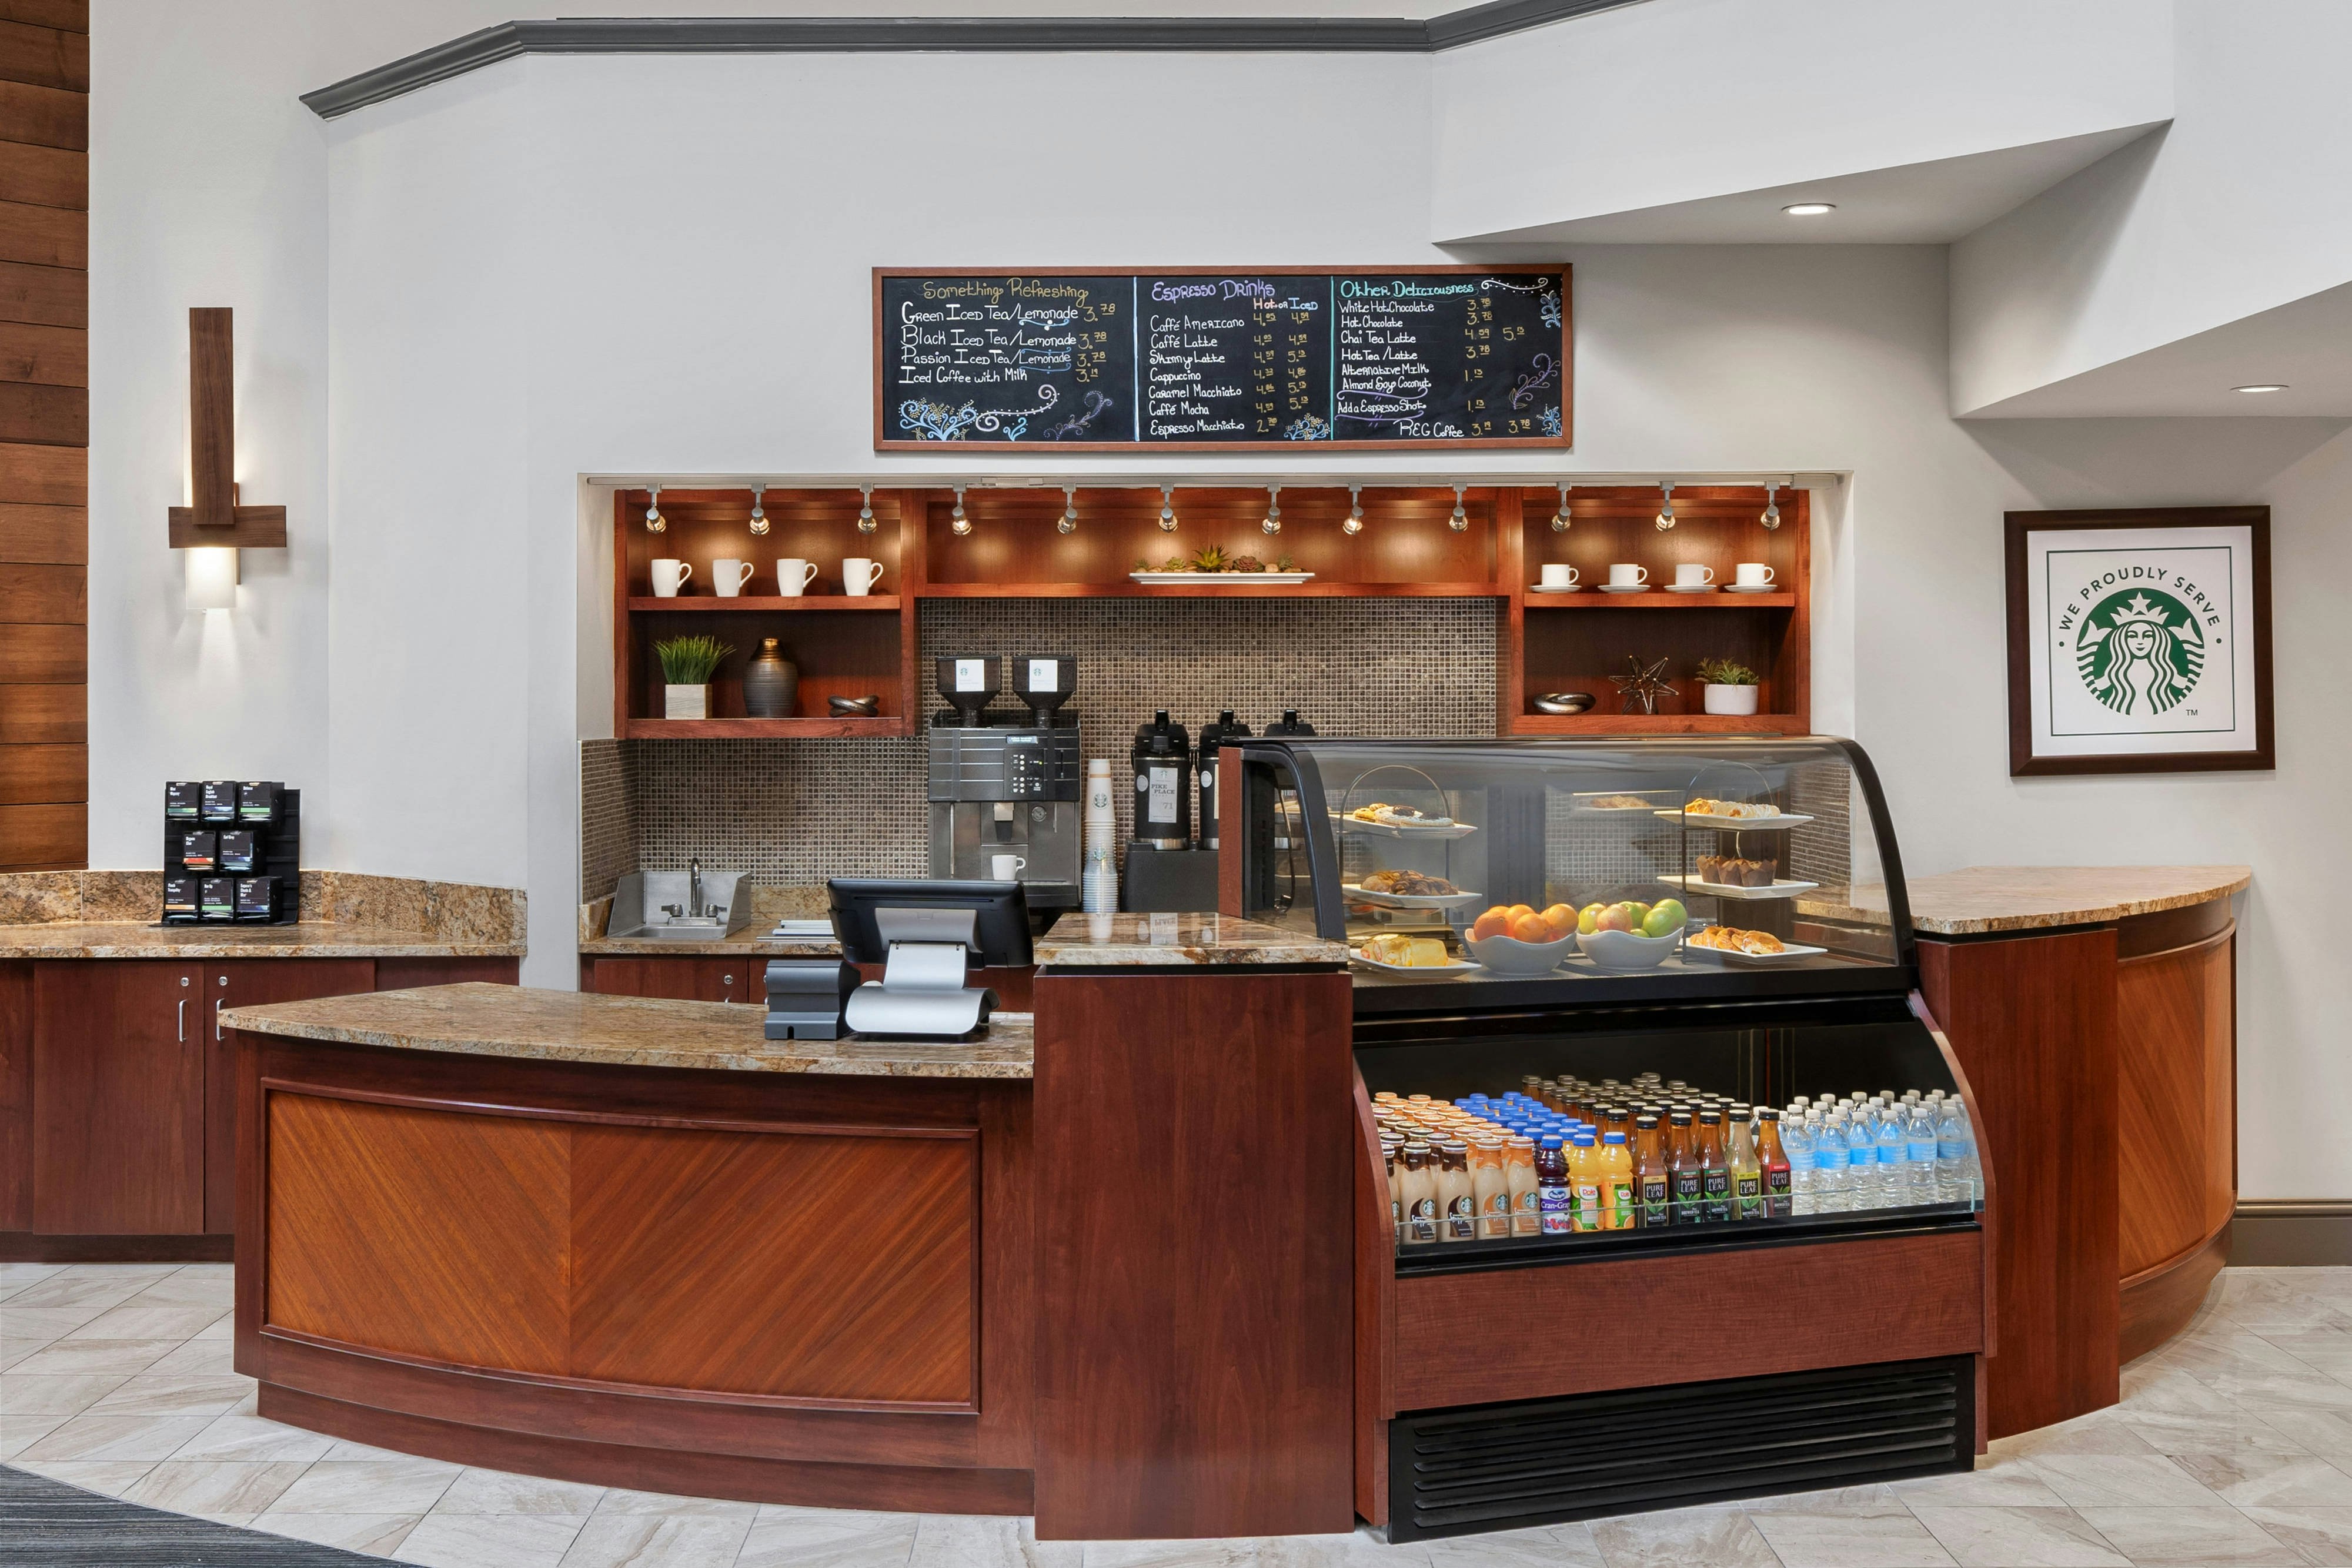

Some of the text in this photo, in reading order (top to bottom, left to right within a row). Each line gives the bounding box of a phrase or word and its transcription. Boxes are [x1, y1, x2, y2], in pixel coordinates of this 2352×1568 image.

[923, 278, 1088, 307] Something Refreshing
[1152, 279, 1275, 304] Espresso Drinks
[1341, 280, 1474, 297] Other Deliciousness
[1253, 297, 1277, 310] Hot
[1288, 297, 1318, 310] Iced
[1338, 300, 1369, 313] White
[1371, 301, 1389, 312] Hot
[1389, 302, 1435, 312] Chocolate
[901, 302, 944, 325] Green
[946, 304, 983, 320] Iced
[1341, 318, 1362, 327] Hot
[1362, 316, 1403, 327] Chocolate
[1184, 315, 1244, 330] Americano
[901, 325, 946, 347] Black
[950, 329, 983, 346] Iced
[1184, 333, 1218, 347] Latte
[1341, 330, 1362, 344] Chai
[1366, 330, 1384, 343] Tea
[1387, 330, 1416, 343] Latte
[901, 346, 951, 365] Passion
[954, 349, 990, 365] Iced
[1150, 350, 1193, 369] Skinny
[1194, 351, 1225, 363] Latte
[1341, 348, 1362, 360] Hot
[899, 366, 931, 383] Iced
[936, 367, 971, 383] Coffee
[974, 373, 1000, 383] with
[1005, 368, 1027, 381] Milk
[1150, 367, 1201, 385] Cappuccino
[1342, 364, 1401, 376] Alternative
[1402, 363, 1429, 374] Milk
[1149, 385, 1189, 399] Caramel
[1194, 384, 1241, 397] Macchiato
[1342, 376, 1431, 393] Almond Soy Coconut
[1181, 402, 1209, 414] Mocha
[1338, 402, 1354, 414] Add
[1360, 400, 1399, 415] Espresso
[1399, 399, 1426, 411] Shot
[1150, 420, 1195, 439] Espresso
[1197, 419, 1244, 432] Macchiato
[1433, 422, 1464, 437] Coffee
[2059, 567, 2220, 631] WE PROUDLY SERVE
